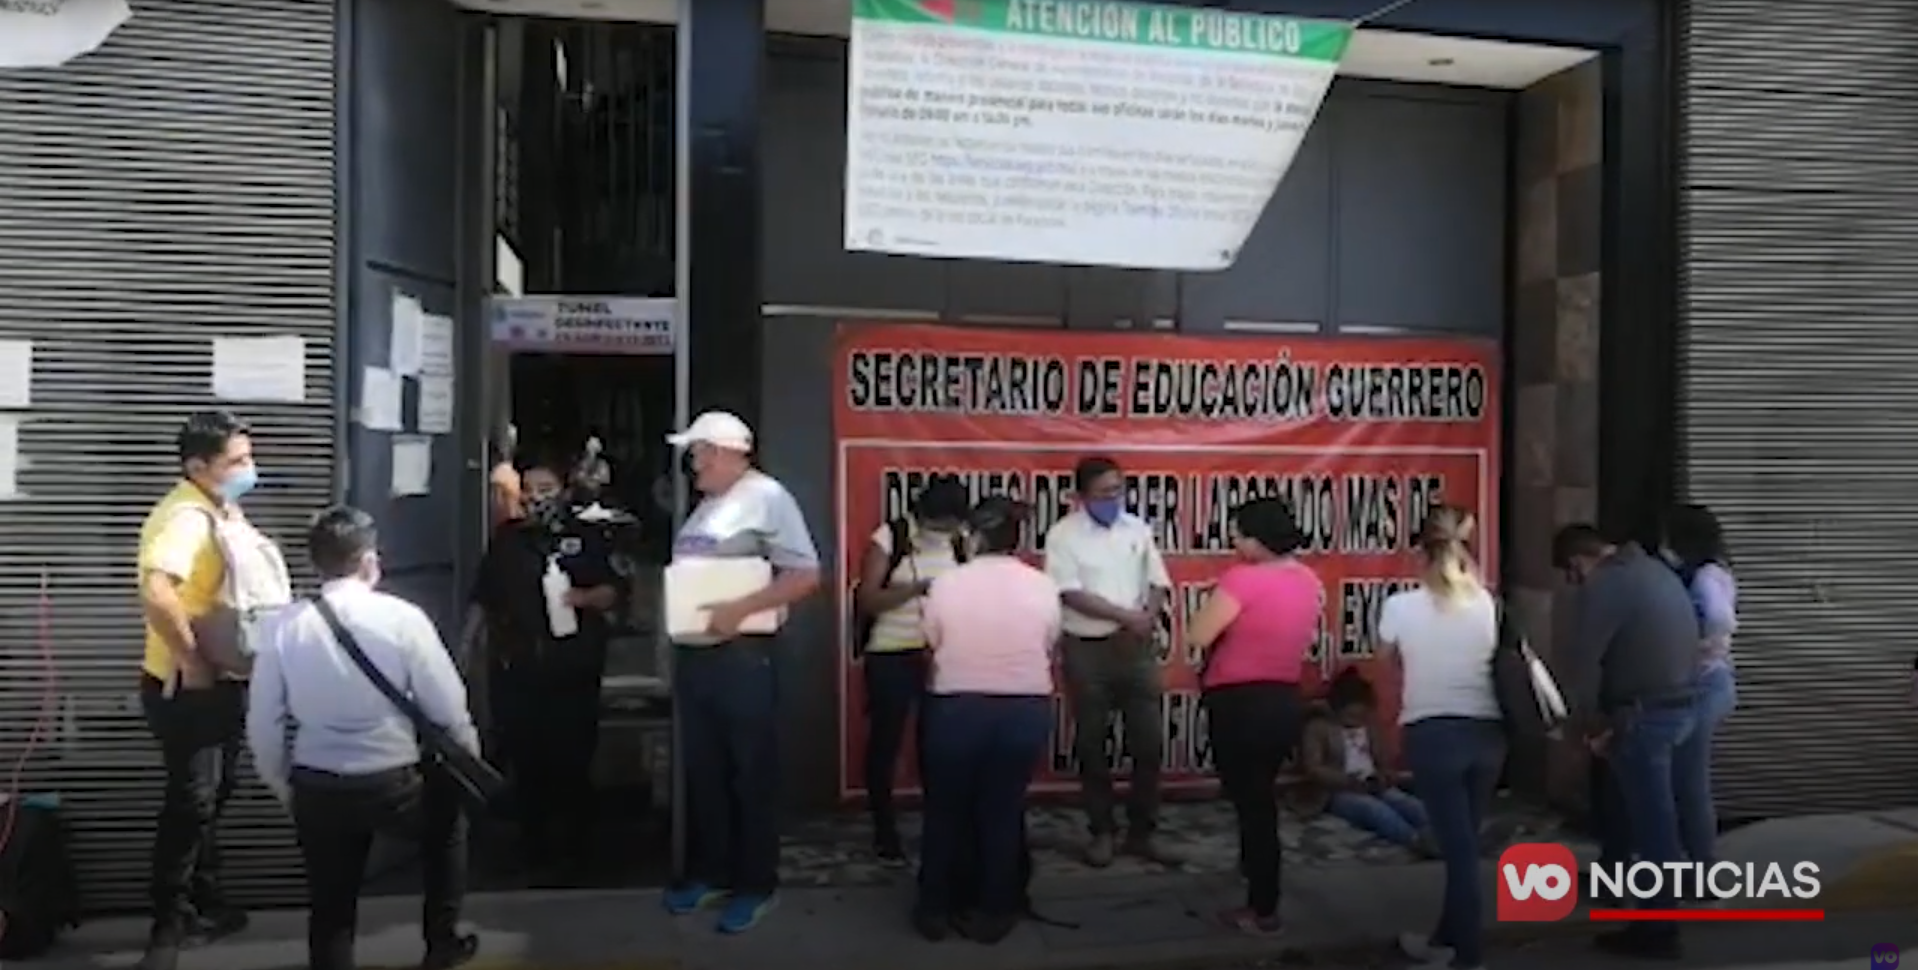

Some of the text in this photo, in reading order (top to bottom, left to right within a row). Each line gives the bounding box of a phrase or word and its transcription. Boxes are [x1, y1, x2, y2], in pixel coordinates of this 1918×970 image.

[1147, 9, 1182, 44] AL
[849, 348, 1484, 418] SECRETARIO DE EDUCACIÓN GUERRERO
